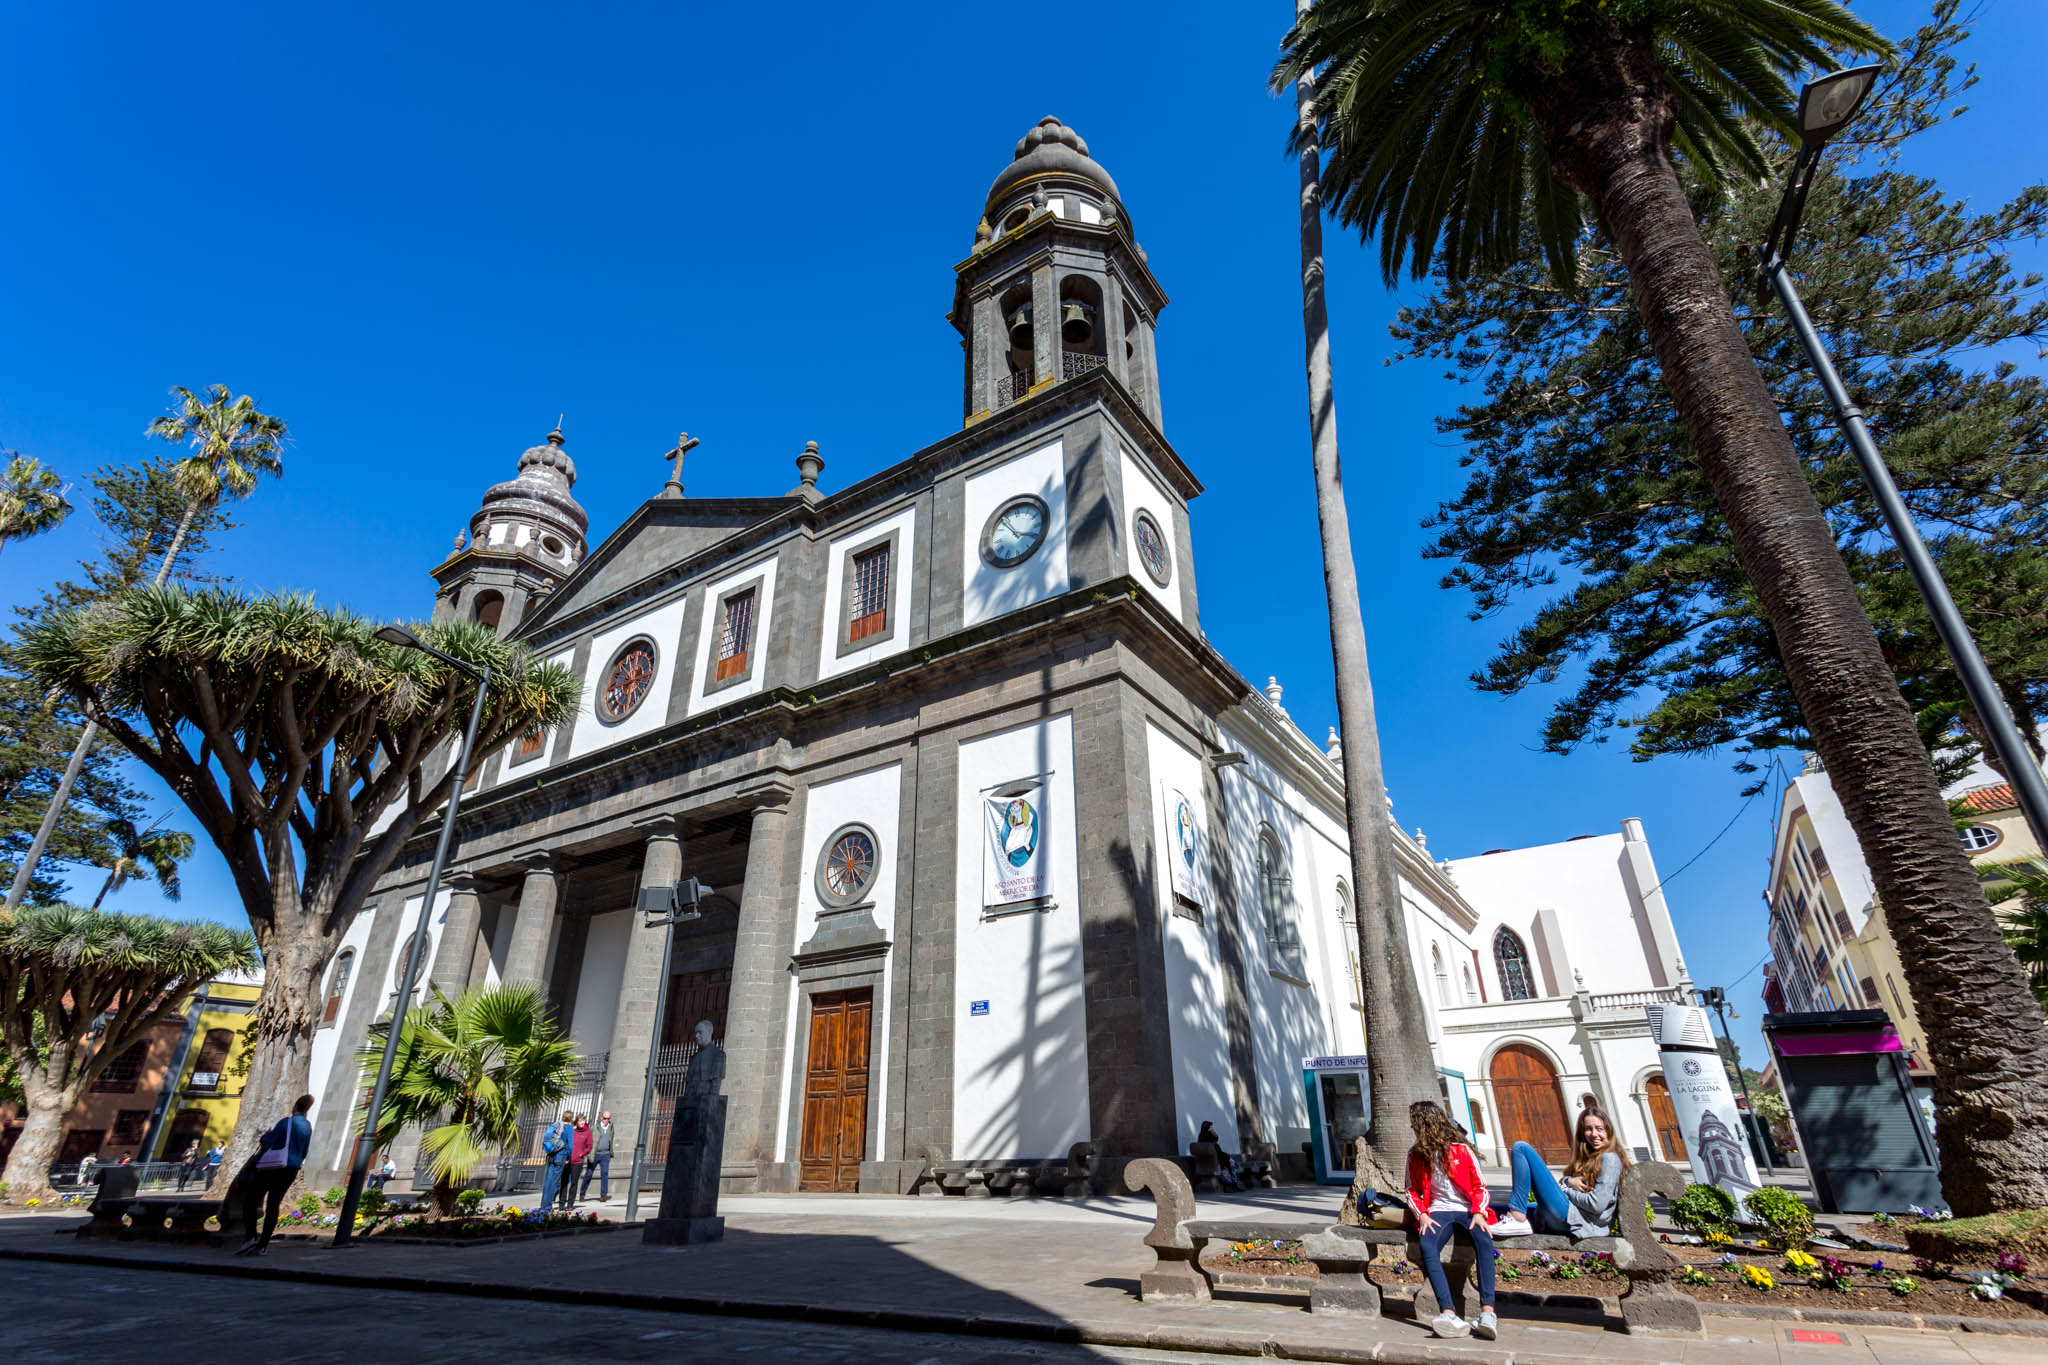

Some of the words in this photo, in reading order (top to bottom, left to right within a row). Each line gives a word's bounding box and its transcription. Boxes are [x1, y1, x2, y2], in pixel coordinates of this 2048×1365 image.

[1007, 877, 1026, 886] SANTO
[999, 884, 1040, 896] MISERICORDIA
[1334, 1058, 1346, 1066] DE
[1347, 1057, 1368, 1065] INFO
[1687, 1085, 1721, 1093] LAGUNA
